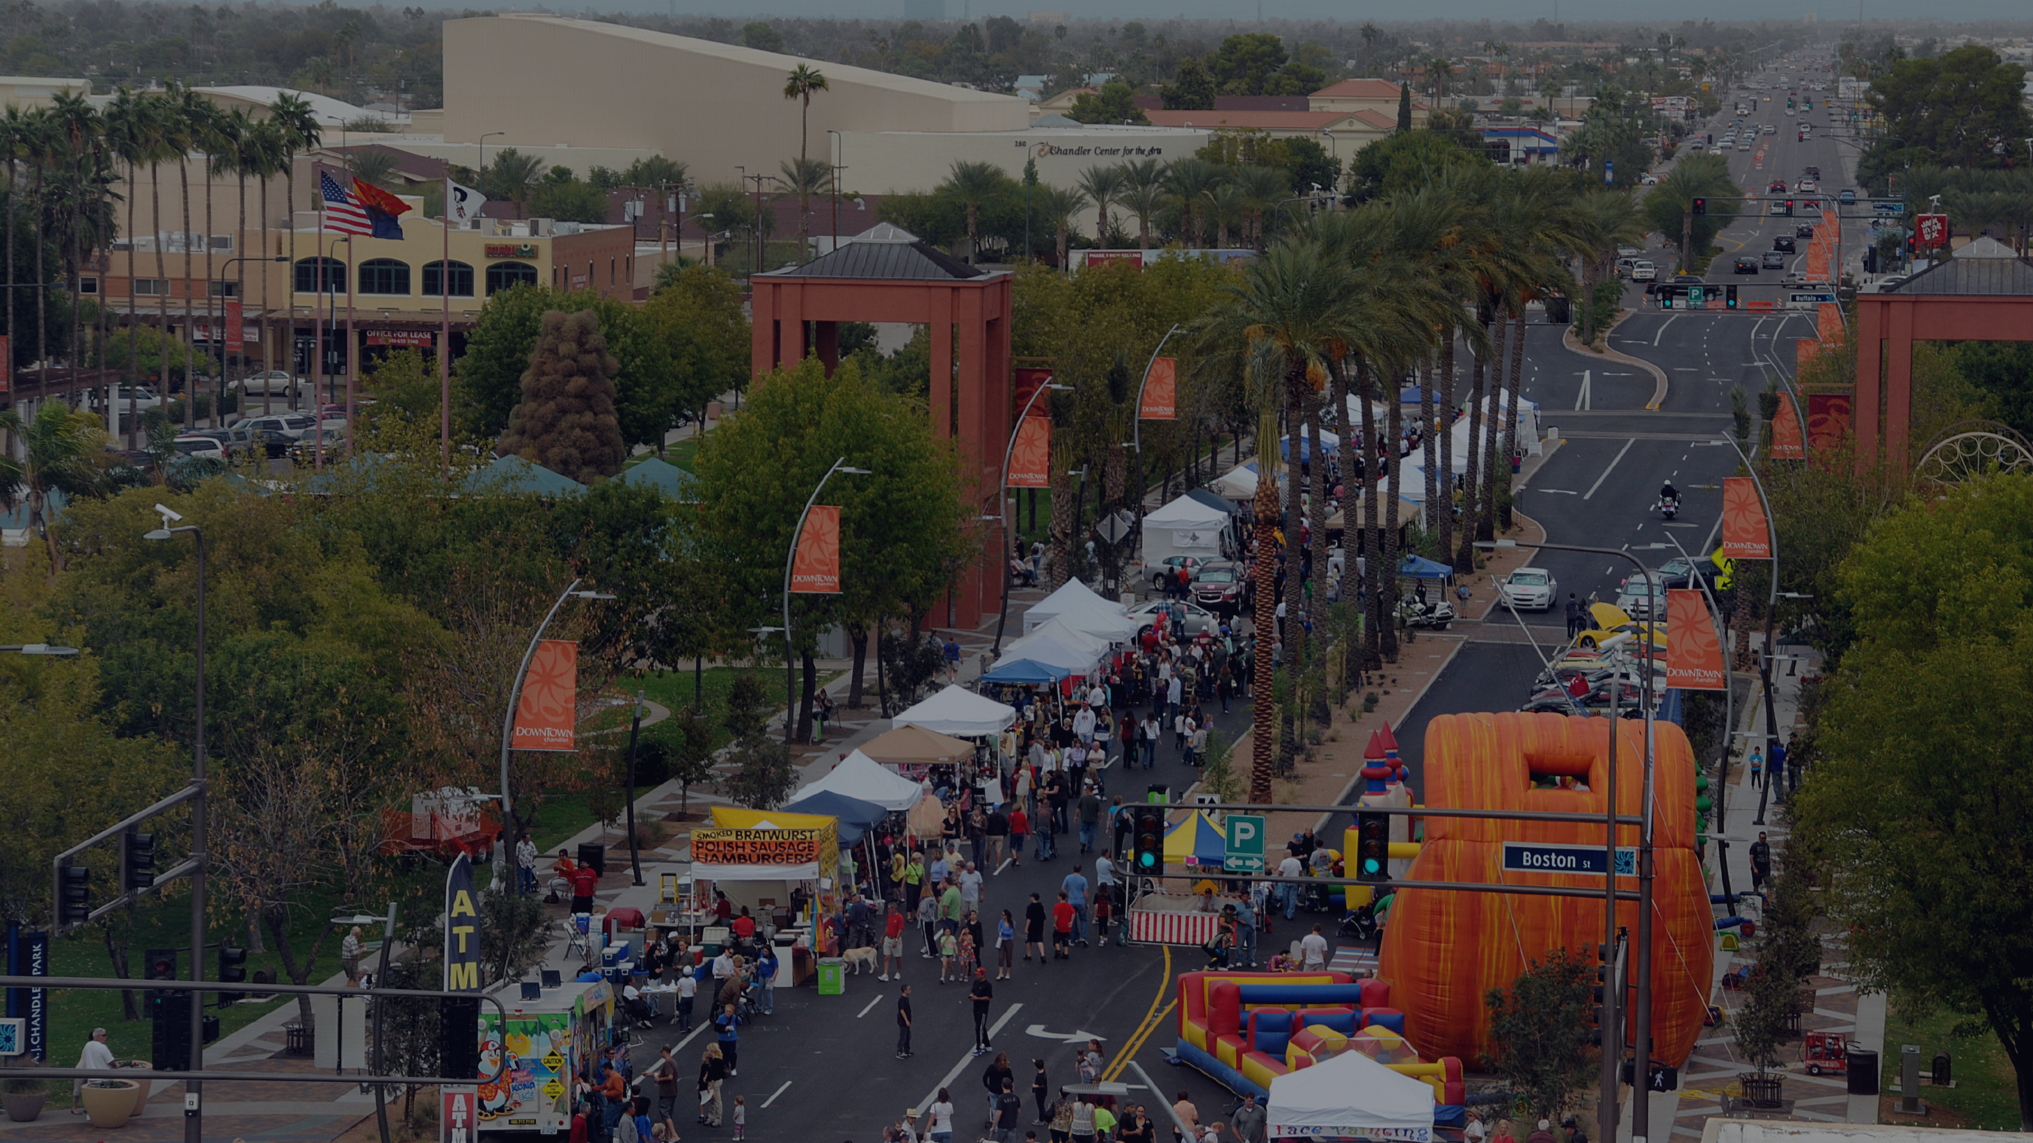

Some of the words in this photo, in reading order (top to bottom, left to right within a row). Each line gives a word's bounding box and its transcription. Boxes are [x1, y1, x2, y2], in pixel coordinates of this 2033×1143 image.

[1050, 145, 1091, 156] Chandler
[1094, 145, 1120, 156] Center
[1121, 145, 1134, 157] for
[1135, 145, 1145, 156] the
[1692, 289, 1700, 298] P
[410, 331, 431, 339] LEASE
[1723, 541, 1768, 550] DOWNTOWN
[793, 574, 838, 583] DOWNTOWN
[1667, 667, 1722, 678] DOWNTOWN
[516, 726, 573, 738] DOWNTOWN
[696, 830, 732, 841] SMOKED
[736, 830, 816, 841] BRATWURST
[1234, 822, 1255, 848] P
[696, 841, 746, 853] POLISH
[750, 841, 815, 852] SAUSAGE
[696, 853, 815, 864] HAMBURGERS
[1522, 851, 1577, 869] Boston
[1582, 859, 1592, 869] St
[450, 889, 478, 991] ATM
[32, 943, 43, 976] PARK
[511, 1081, 536, 1092] KONA
[452, 1094, 467, 1143] ATM
